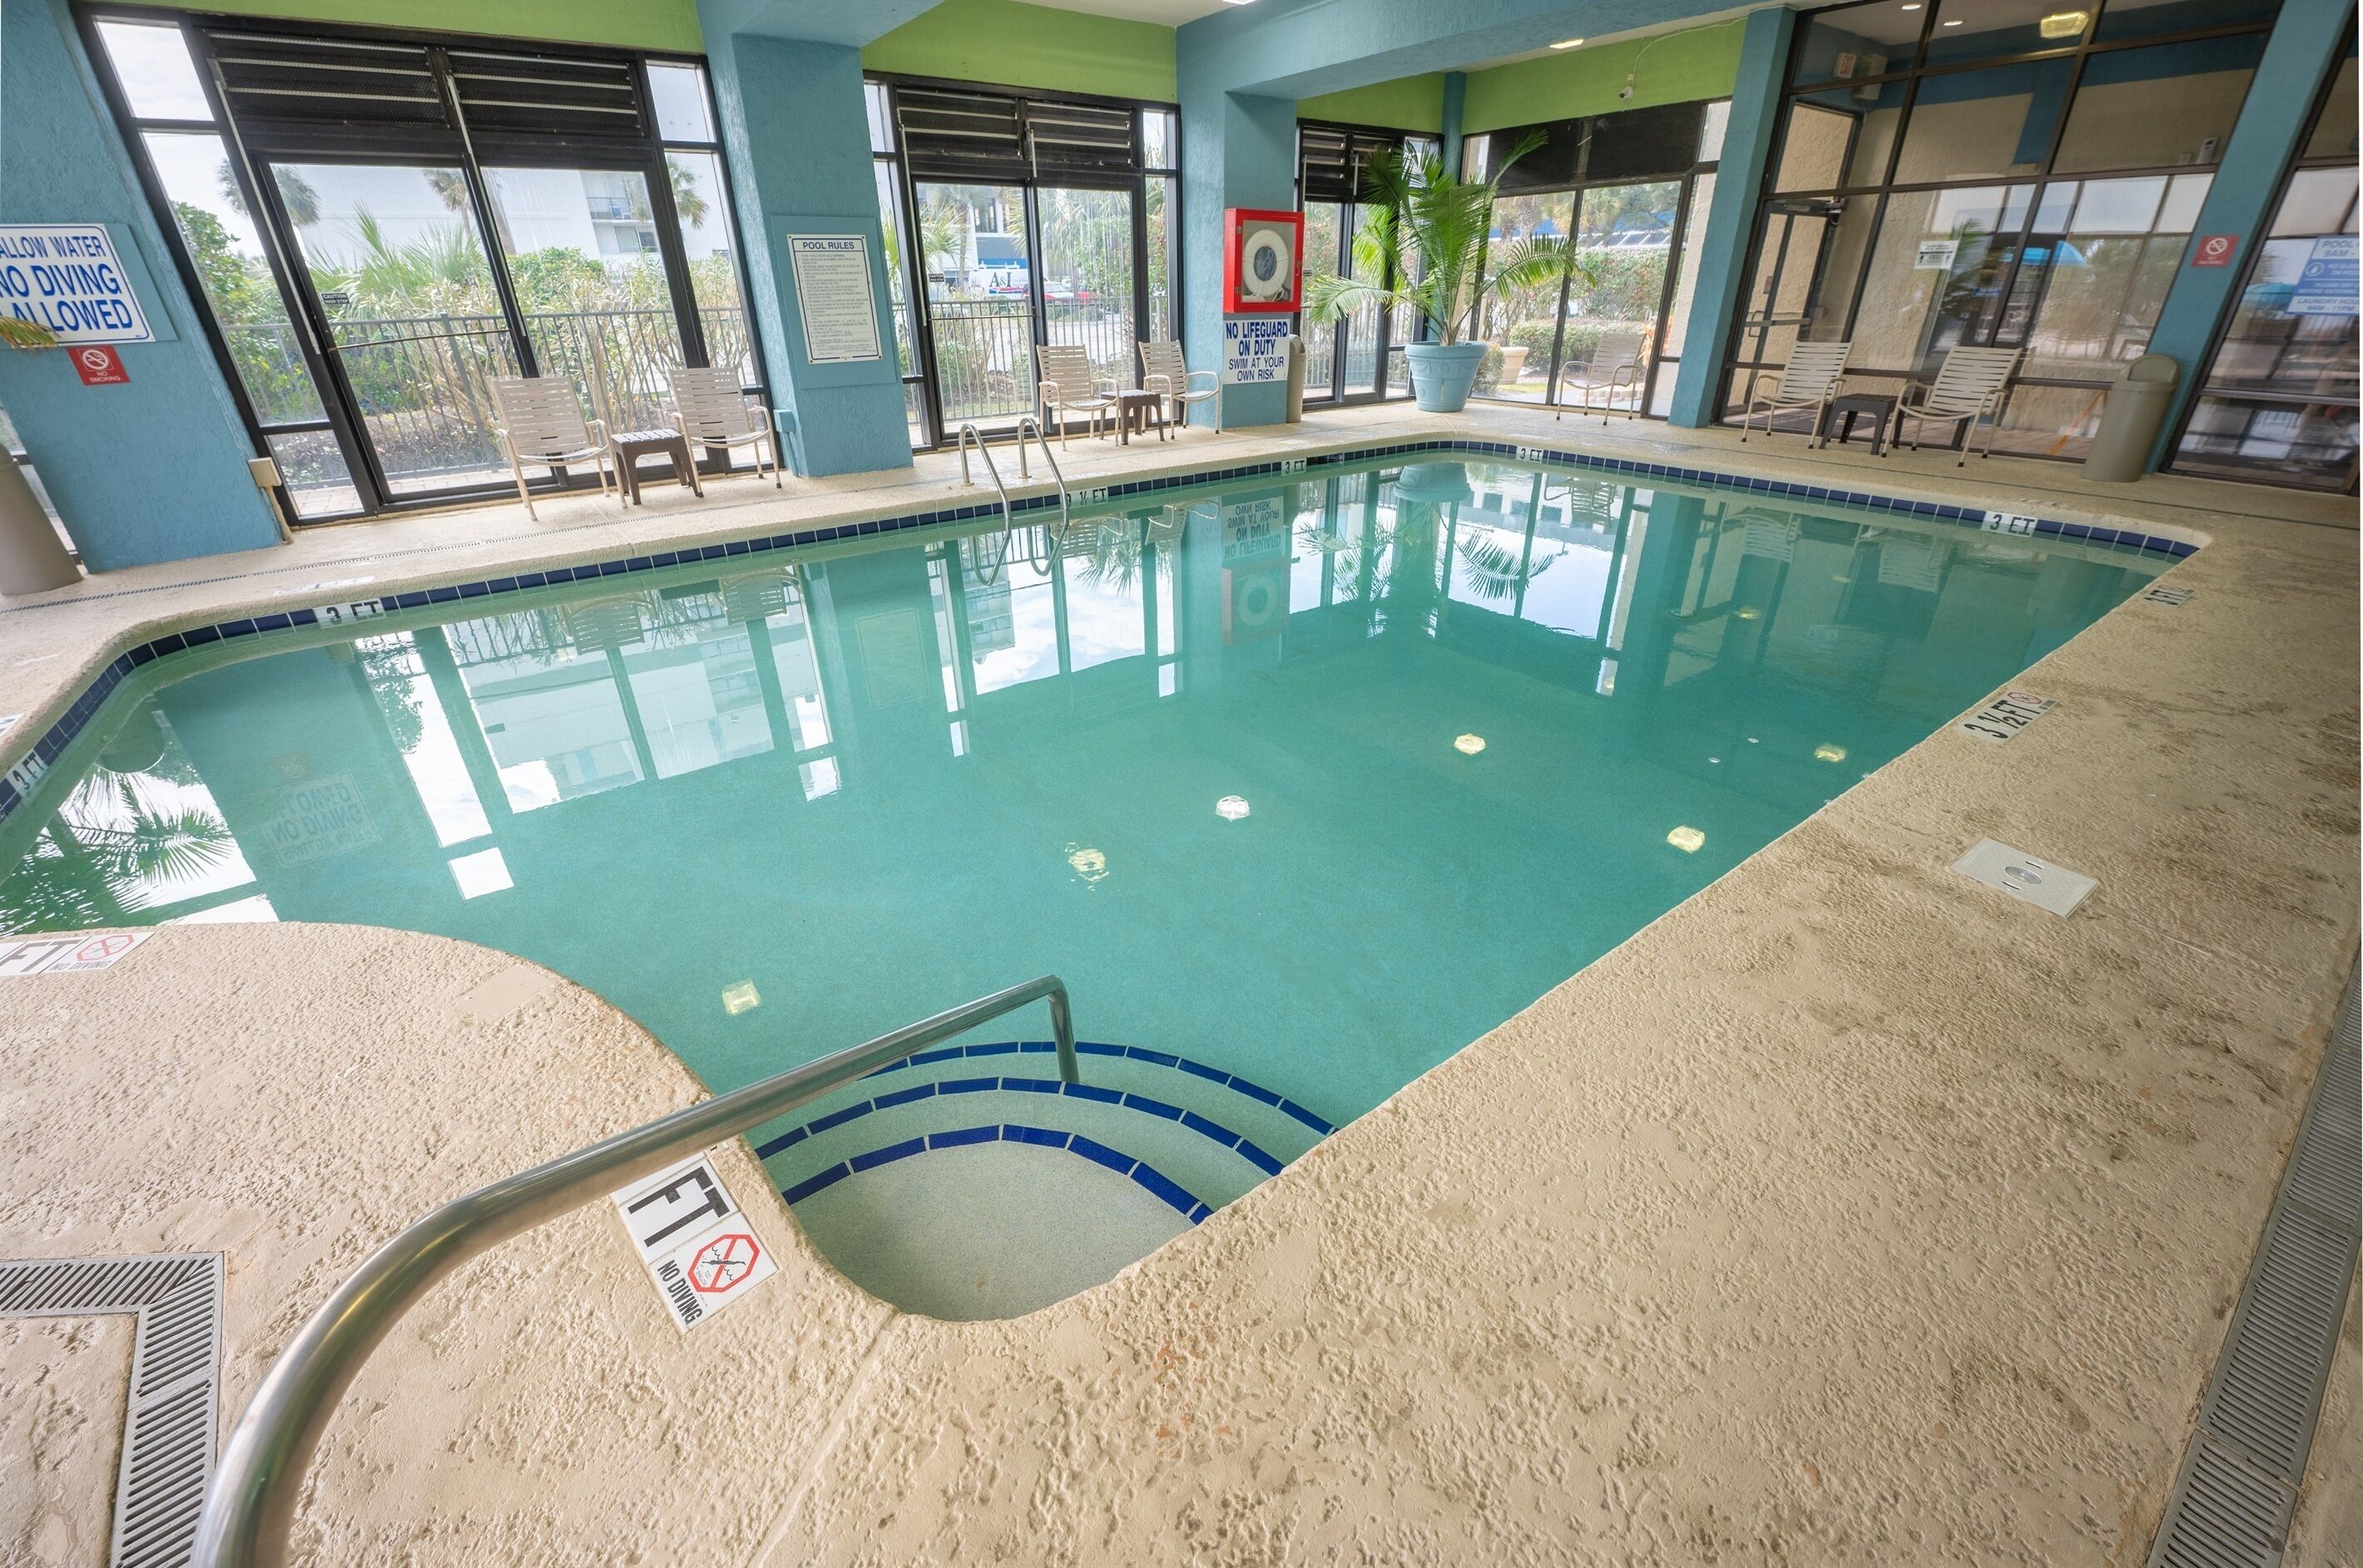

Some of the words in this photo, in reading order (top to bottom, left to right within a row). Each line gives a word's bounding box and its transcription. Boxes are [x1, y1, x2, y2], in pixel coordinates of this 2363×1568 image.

[48, 235, 107, 257] WATER
[803, 241, 826, 250] POOL
[829, 241, 855, 250] RULES
[2322, 240, 2354, 248] POOL
[31, 264, 123, 296] DIVING
[1226, 323, 1238, 339] NO
[1242, 321, 1288, 339] LIFEGUARD
[1238, 340, 1250, 357] ON
[1254, 339, 1276, 356] DUTY
[1229, 358, 1248, 370] SWIM
[1251, 358, 1261, 369] AT
[1264, 356, 1285, 368] YOUR
[1237, 370, 1255, 381] OWN
[1258, 369, 1275, 379] RISK
[1964, 723, 2009, 739] 3
[1990, 700, 2041, 720] FT
[0, 939, 83, 972] FT
[627, 1165, 730, 1248] FT
[657, 1259, 681, 1282] NO
[667, 1277, 703, 1324] DIVING
